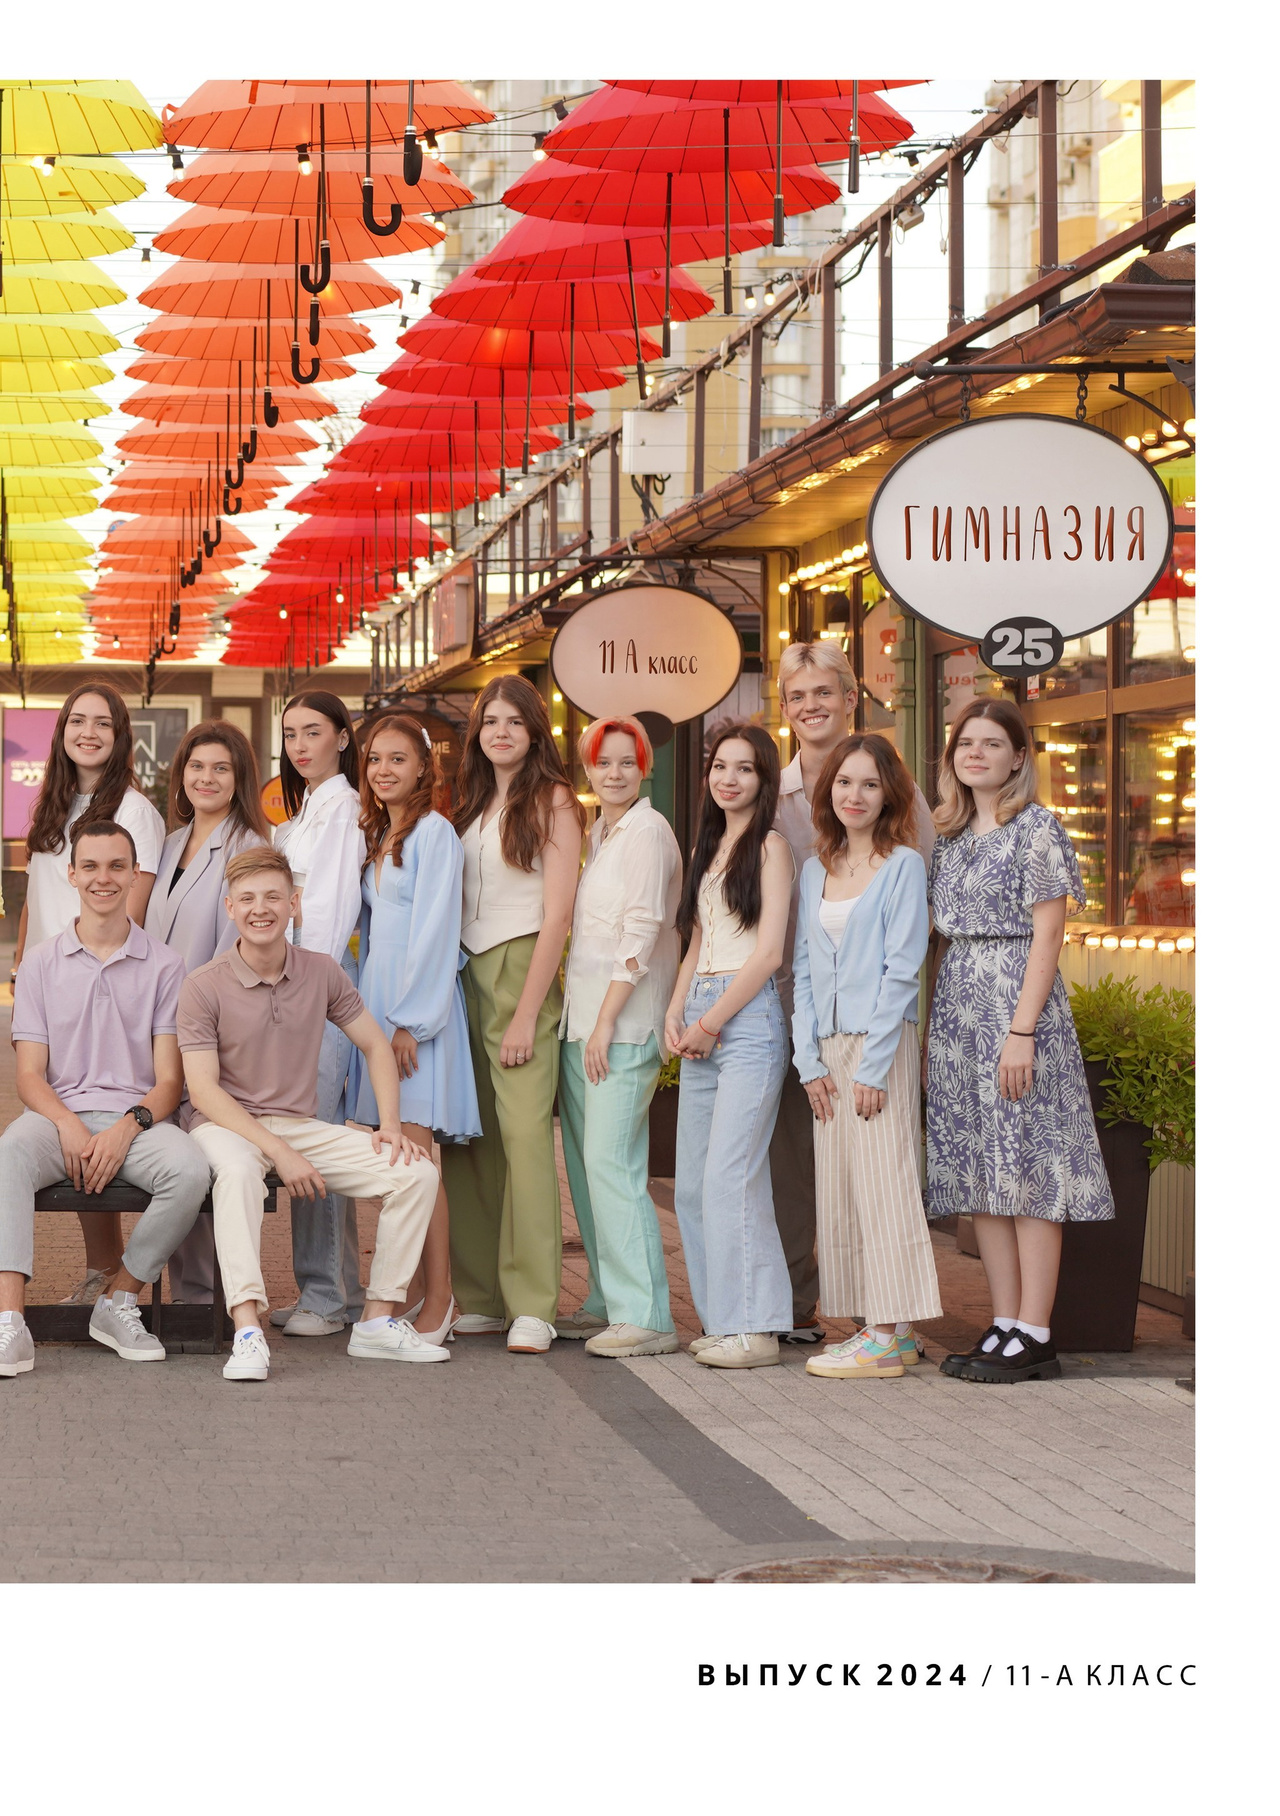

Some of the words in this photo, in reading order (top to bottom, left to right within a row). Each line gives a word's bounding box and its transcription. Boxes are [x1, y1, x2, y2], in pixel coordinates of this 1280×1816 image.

[904, 505, 1145, 563] ГИМНАЗИЯ
[599, 640, 615, 674] 11
[648, 655, 698, 674] класс
[992, 627, 1054, 667] 25
